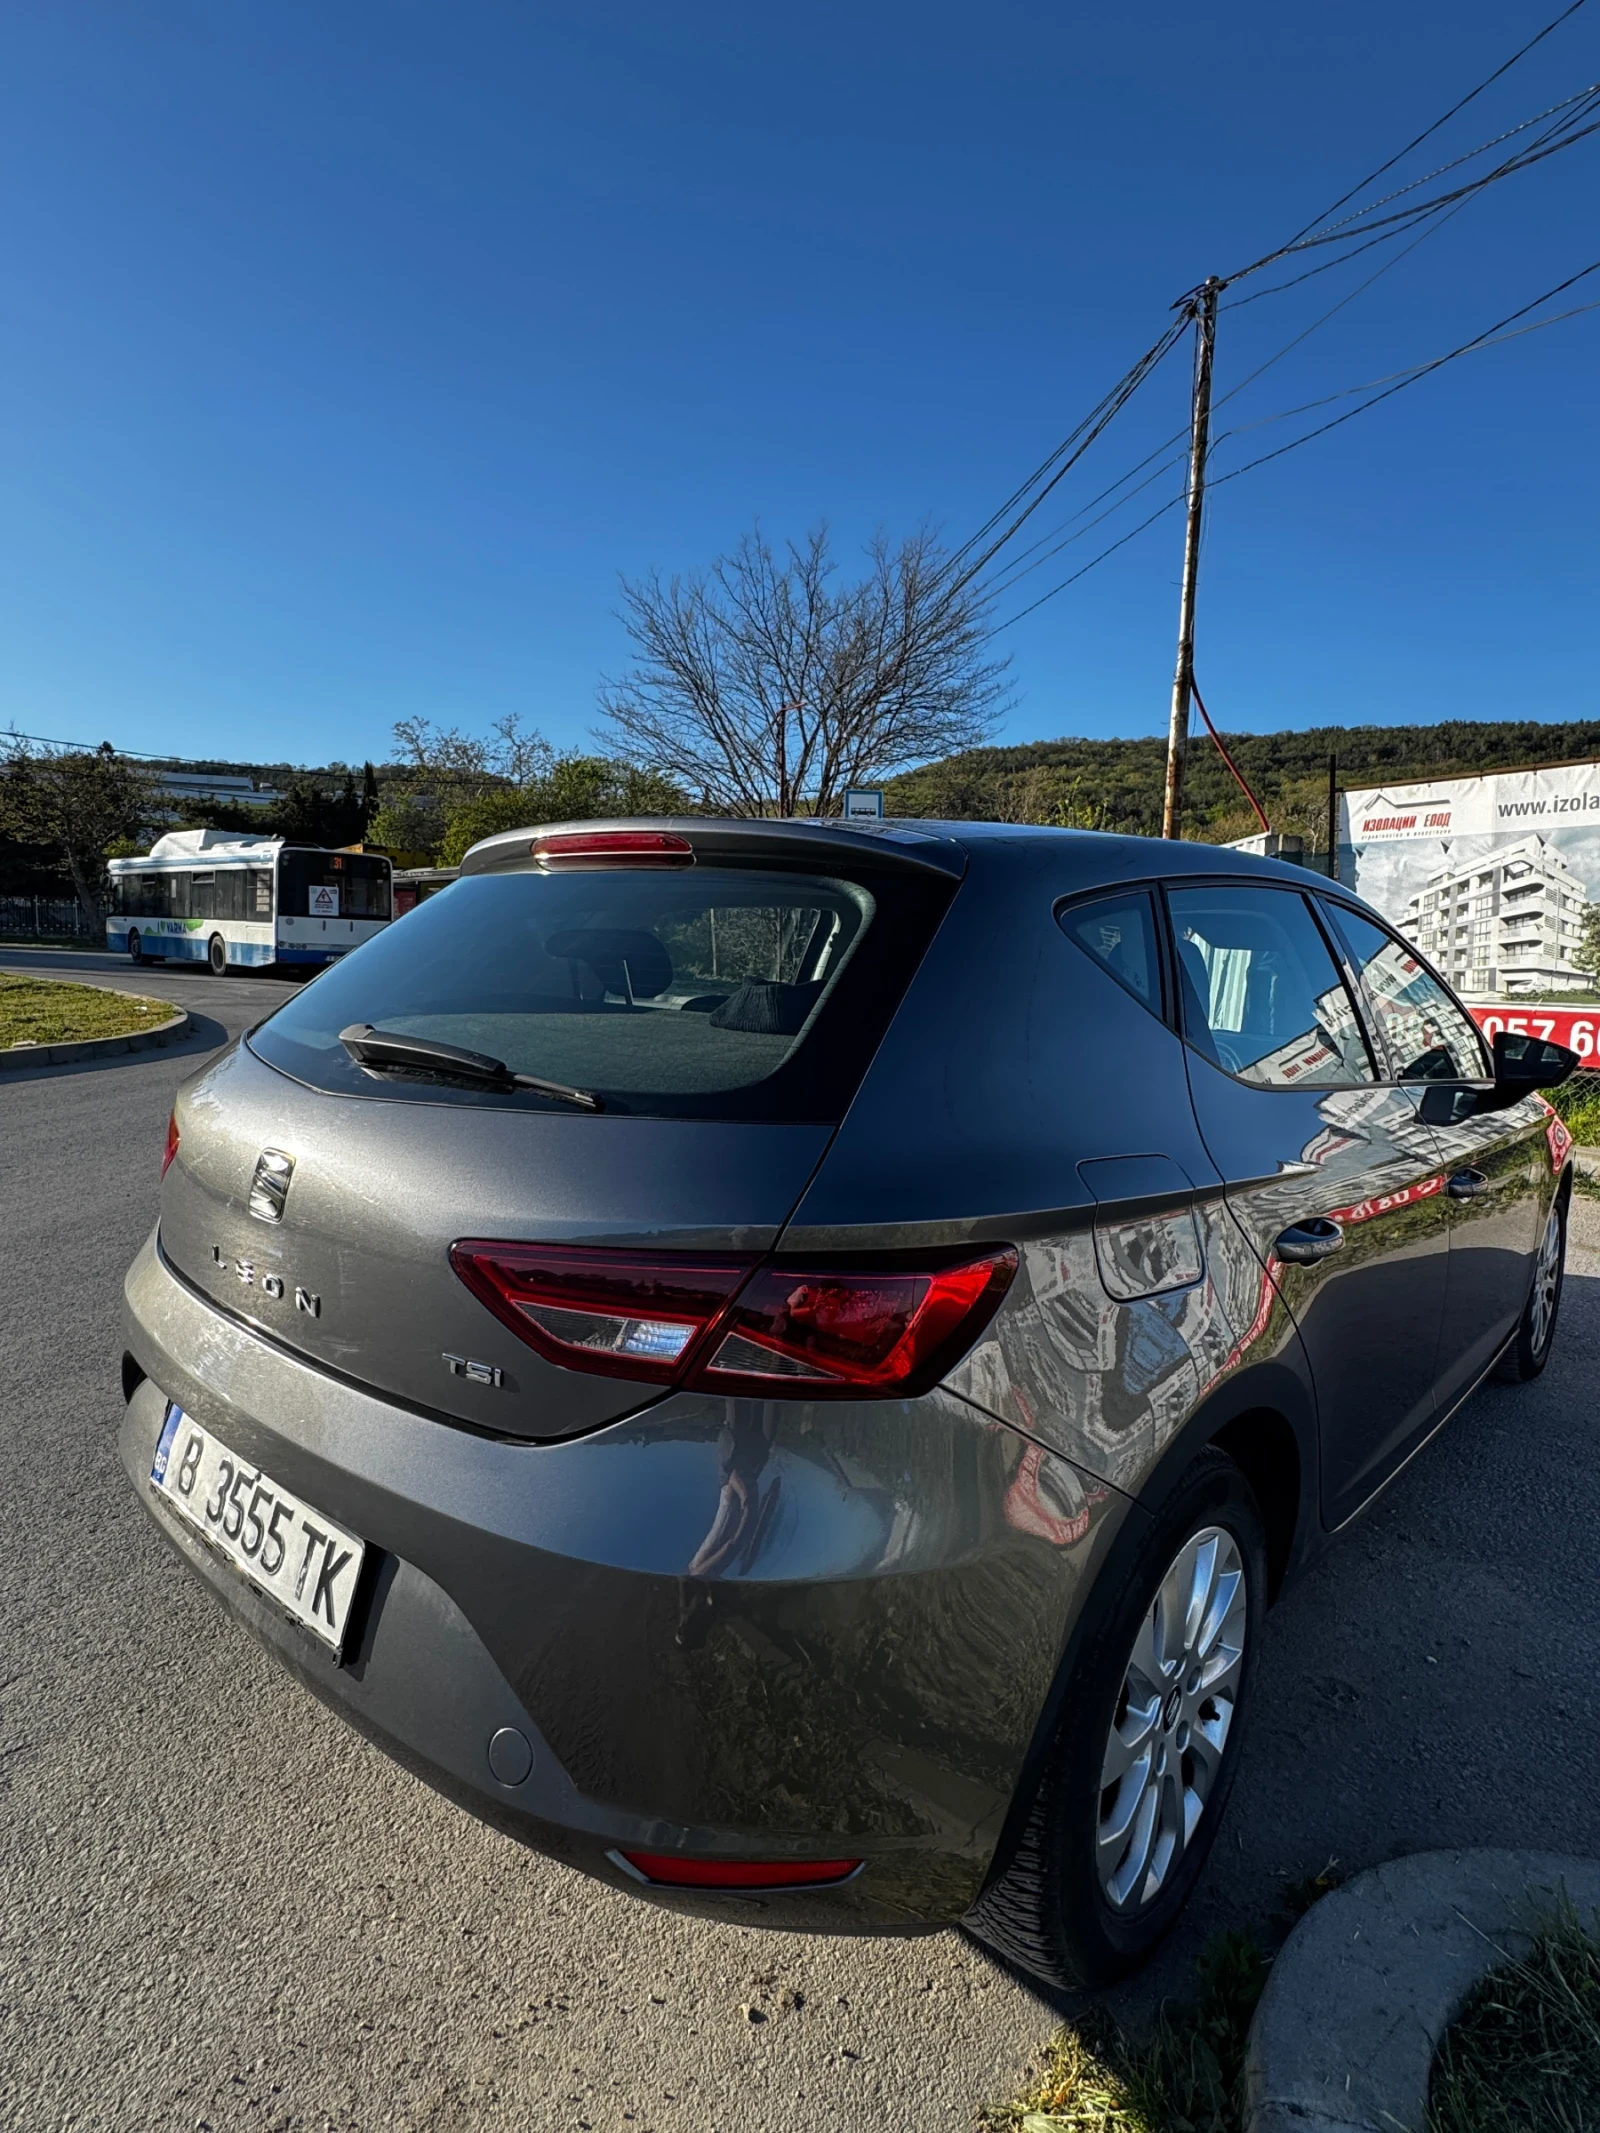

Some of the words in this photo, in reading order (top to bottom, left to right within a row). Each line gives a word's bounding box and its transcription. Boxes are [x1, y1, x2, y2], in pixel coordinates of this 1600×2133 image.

[1498, 792, 1600, 817] www.izola
[1362, 815, 1417, 831] ИЗОЛАЦИИ
[1424, 812, 1451, 828] ЕООД
[333, 857, 342, 869] 31
[166, 921, 187, 935] VARNA
[1569, 1021, 1600, 1058] 6
[211, 1244, 321, 1318] LEON
[442, 1352, 503, 1388] TSI
[154, 1451, 168, 1474] BG
[178, 1429, 204, 1498] B
[205, 1455, 295, 1576] 3555
[294, 1520, 353, 1629] TK
